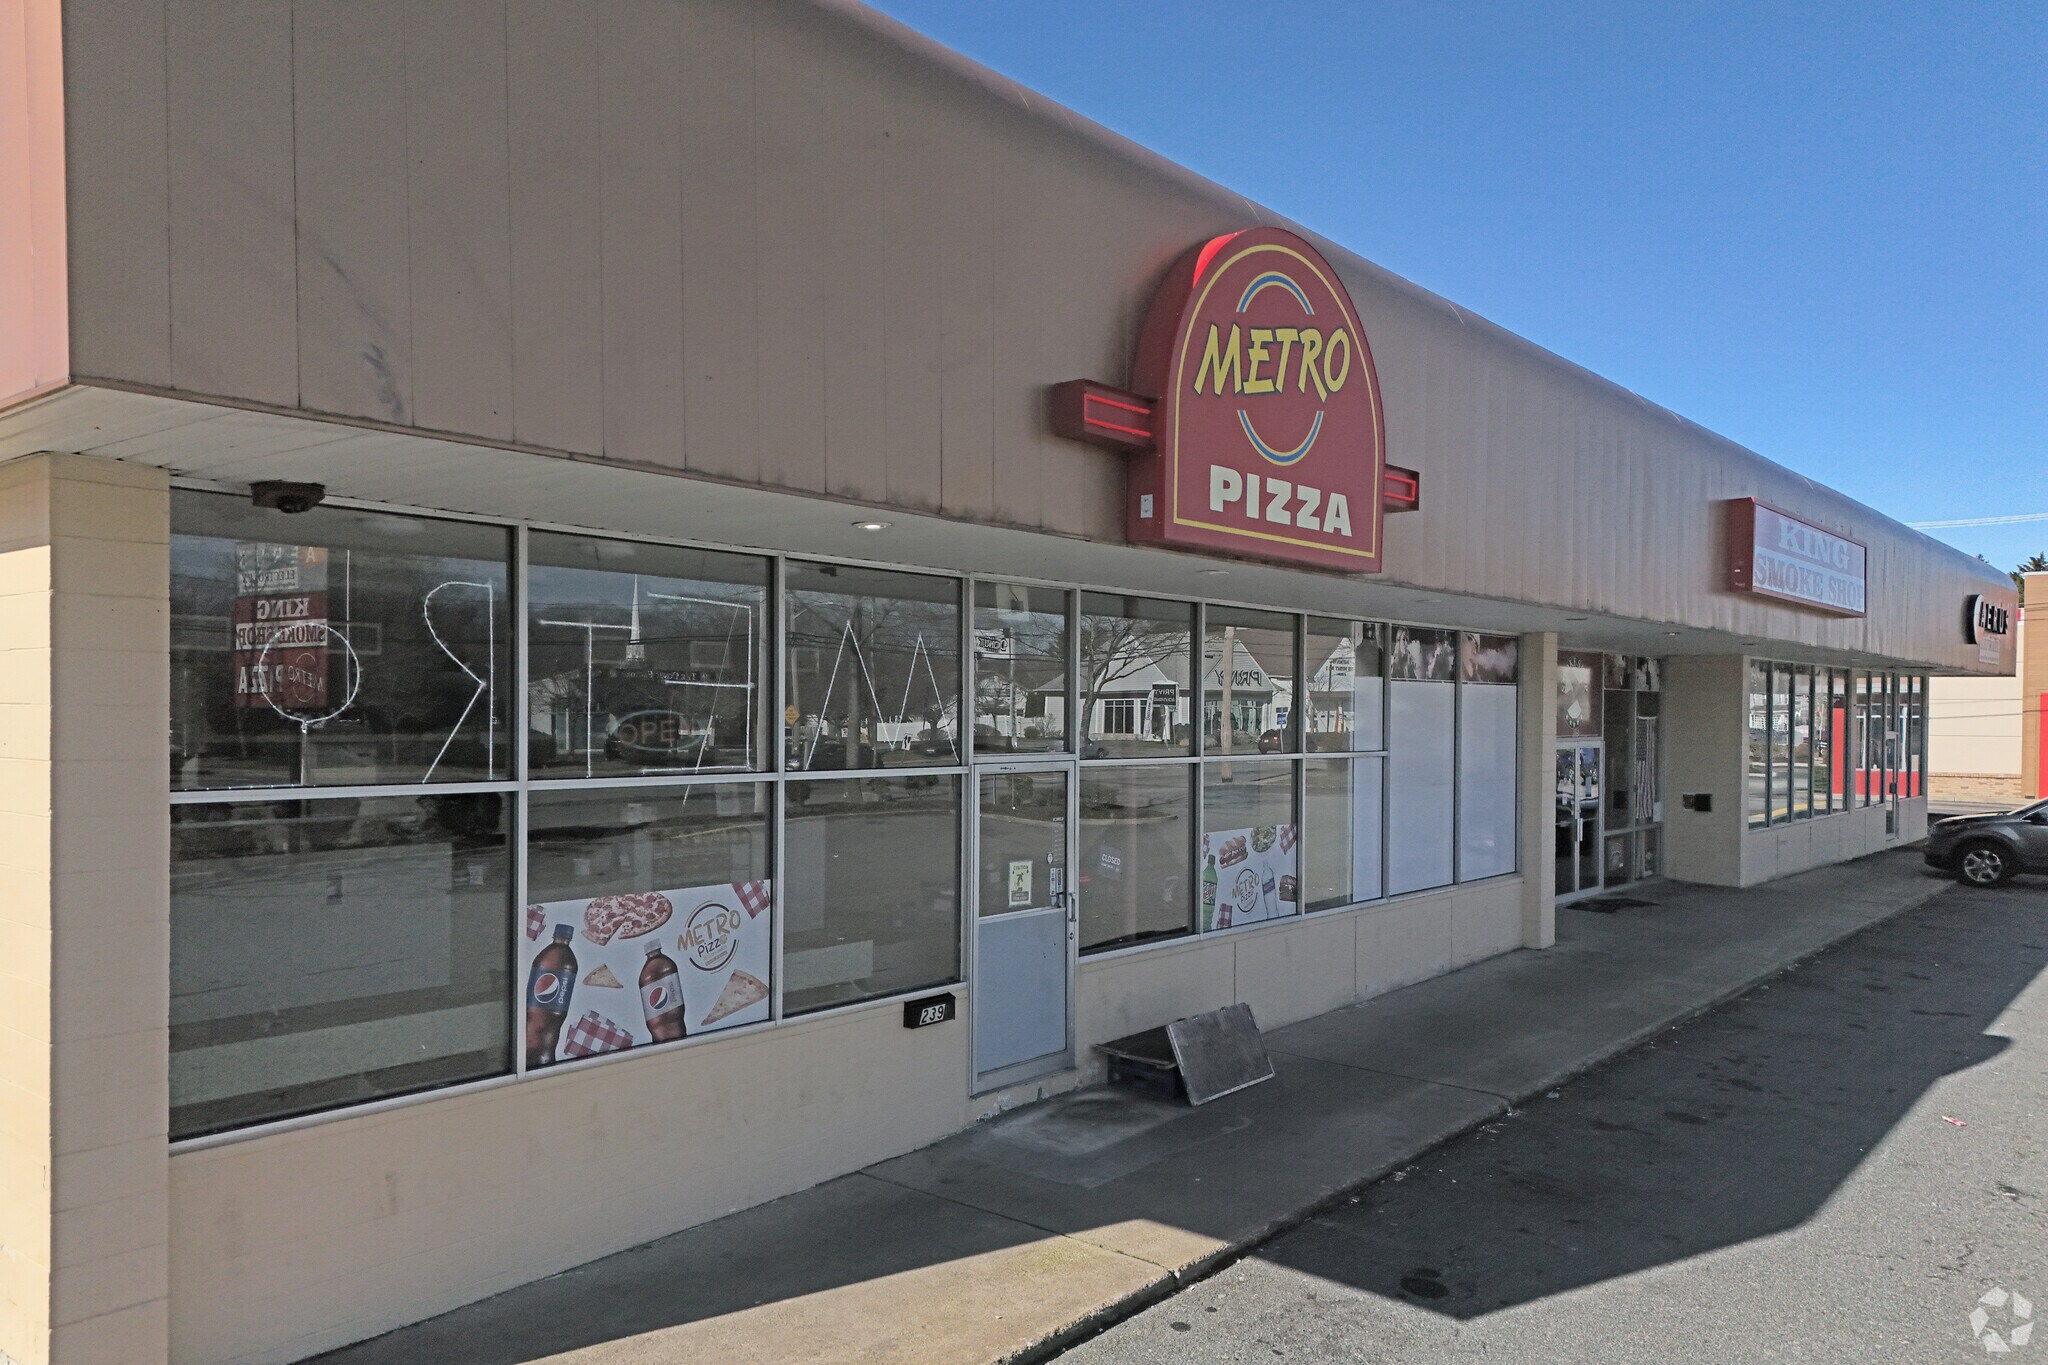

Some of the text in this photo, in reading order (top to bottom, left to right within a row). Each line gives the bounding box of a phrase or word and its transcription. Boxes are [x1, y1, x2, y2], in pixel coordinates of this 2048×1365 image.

[1193, 322, 1351, 403] METRO
[1209, 464, 1353, 538] PIZZA
[1778, 518, 1850, 570] KING
[1754, 553, 1823, 600] SMOKE
[1101, 853, 1121, 866] CLOSED
[677, 909, 741, 952] METRO
[558, 977, 569, 1005] pepsi
[921, 1005, 944, 1024] 239
